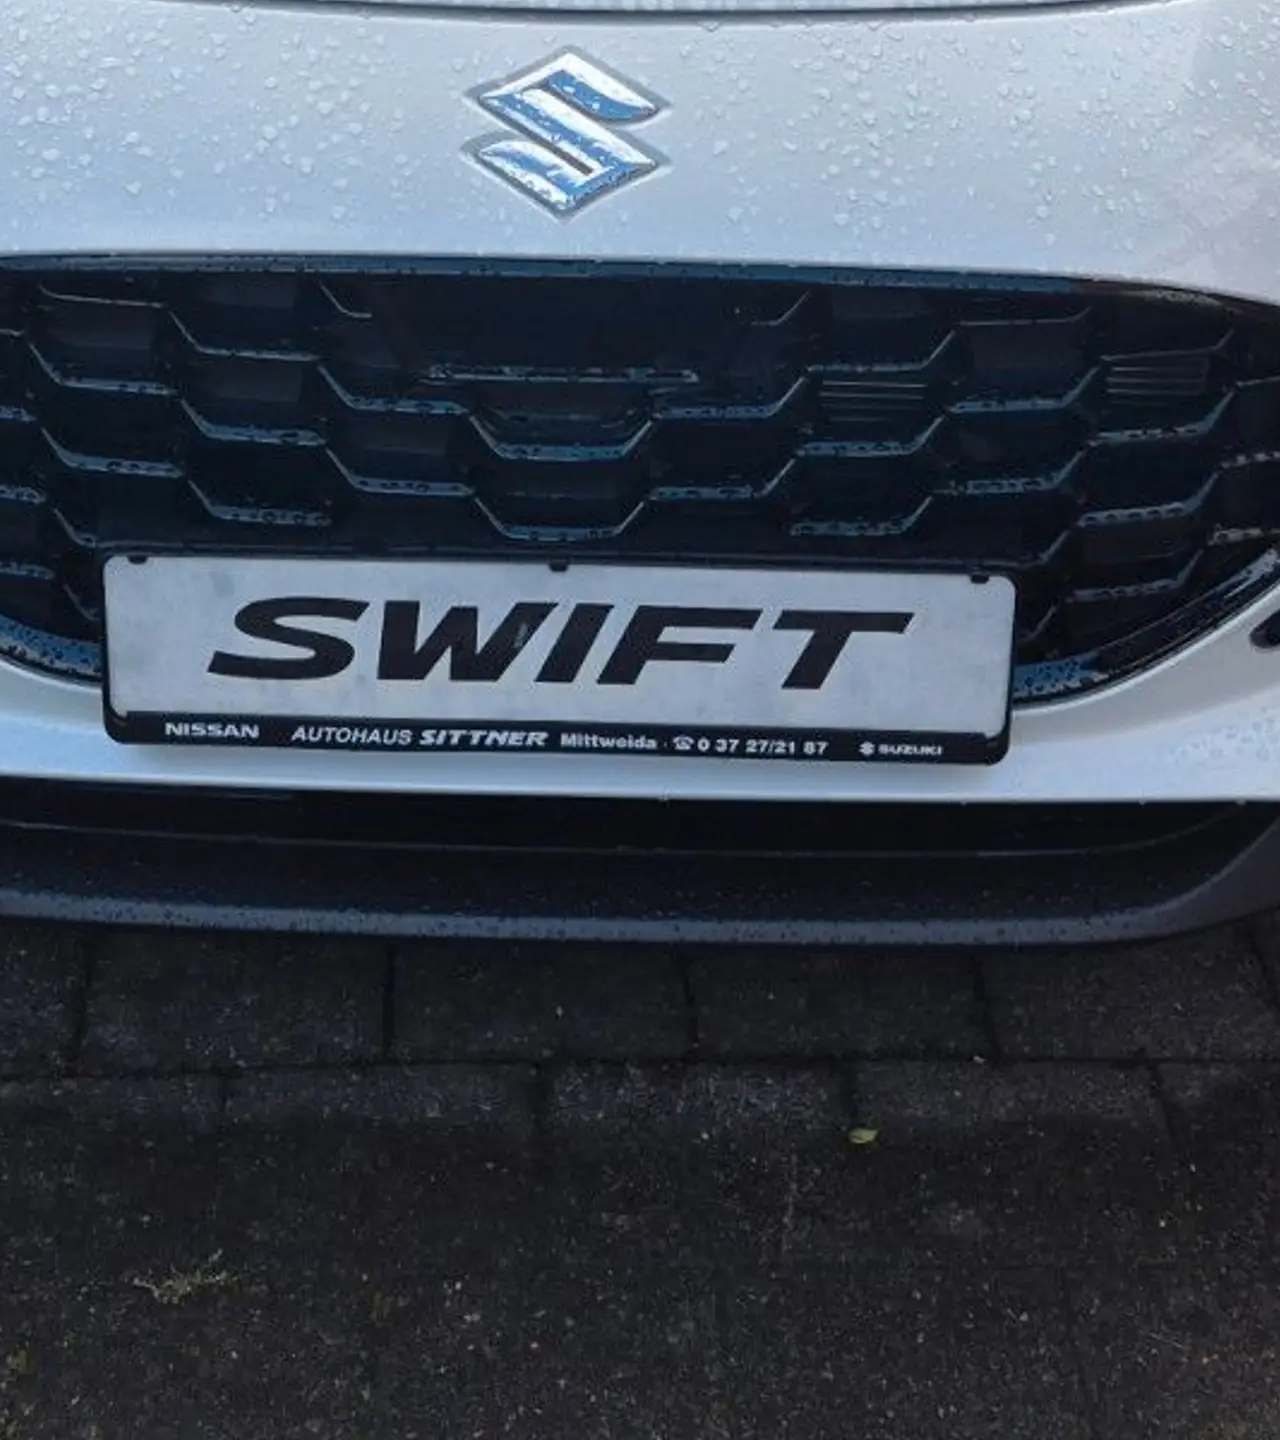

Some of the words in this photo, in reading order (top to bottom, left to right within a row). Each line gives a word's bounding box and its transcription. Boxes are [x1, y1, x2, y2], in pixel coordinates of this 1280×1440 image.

[206, 596, 916, 691] SWIFT
[164, 721, 260, 739] NISSAN
[291, 724, 412, 746] AUTOHAUS
[419, 729, 549, 747] SITTNER
[560, 732, 658, 750] Mittweida
[715, 738, 739, 753] 37
[745, 739, 796, 755] 27/21
[878, 743, 944, 757] SUZUKI
